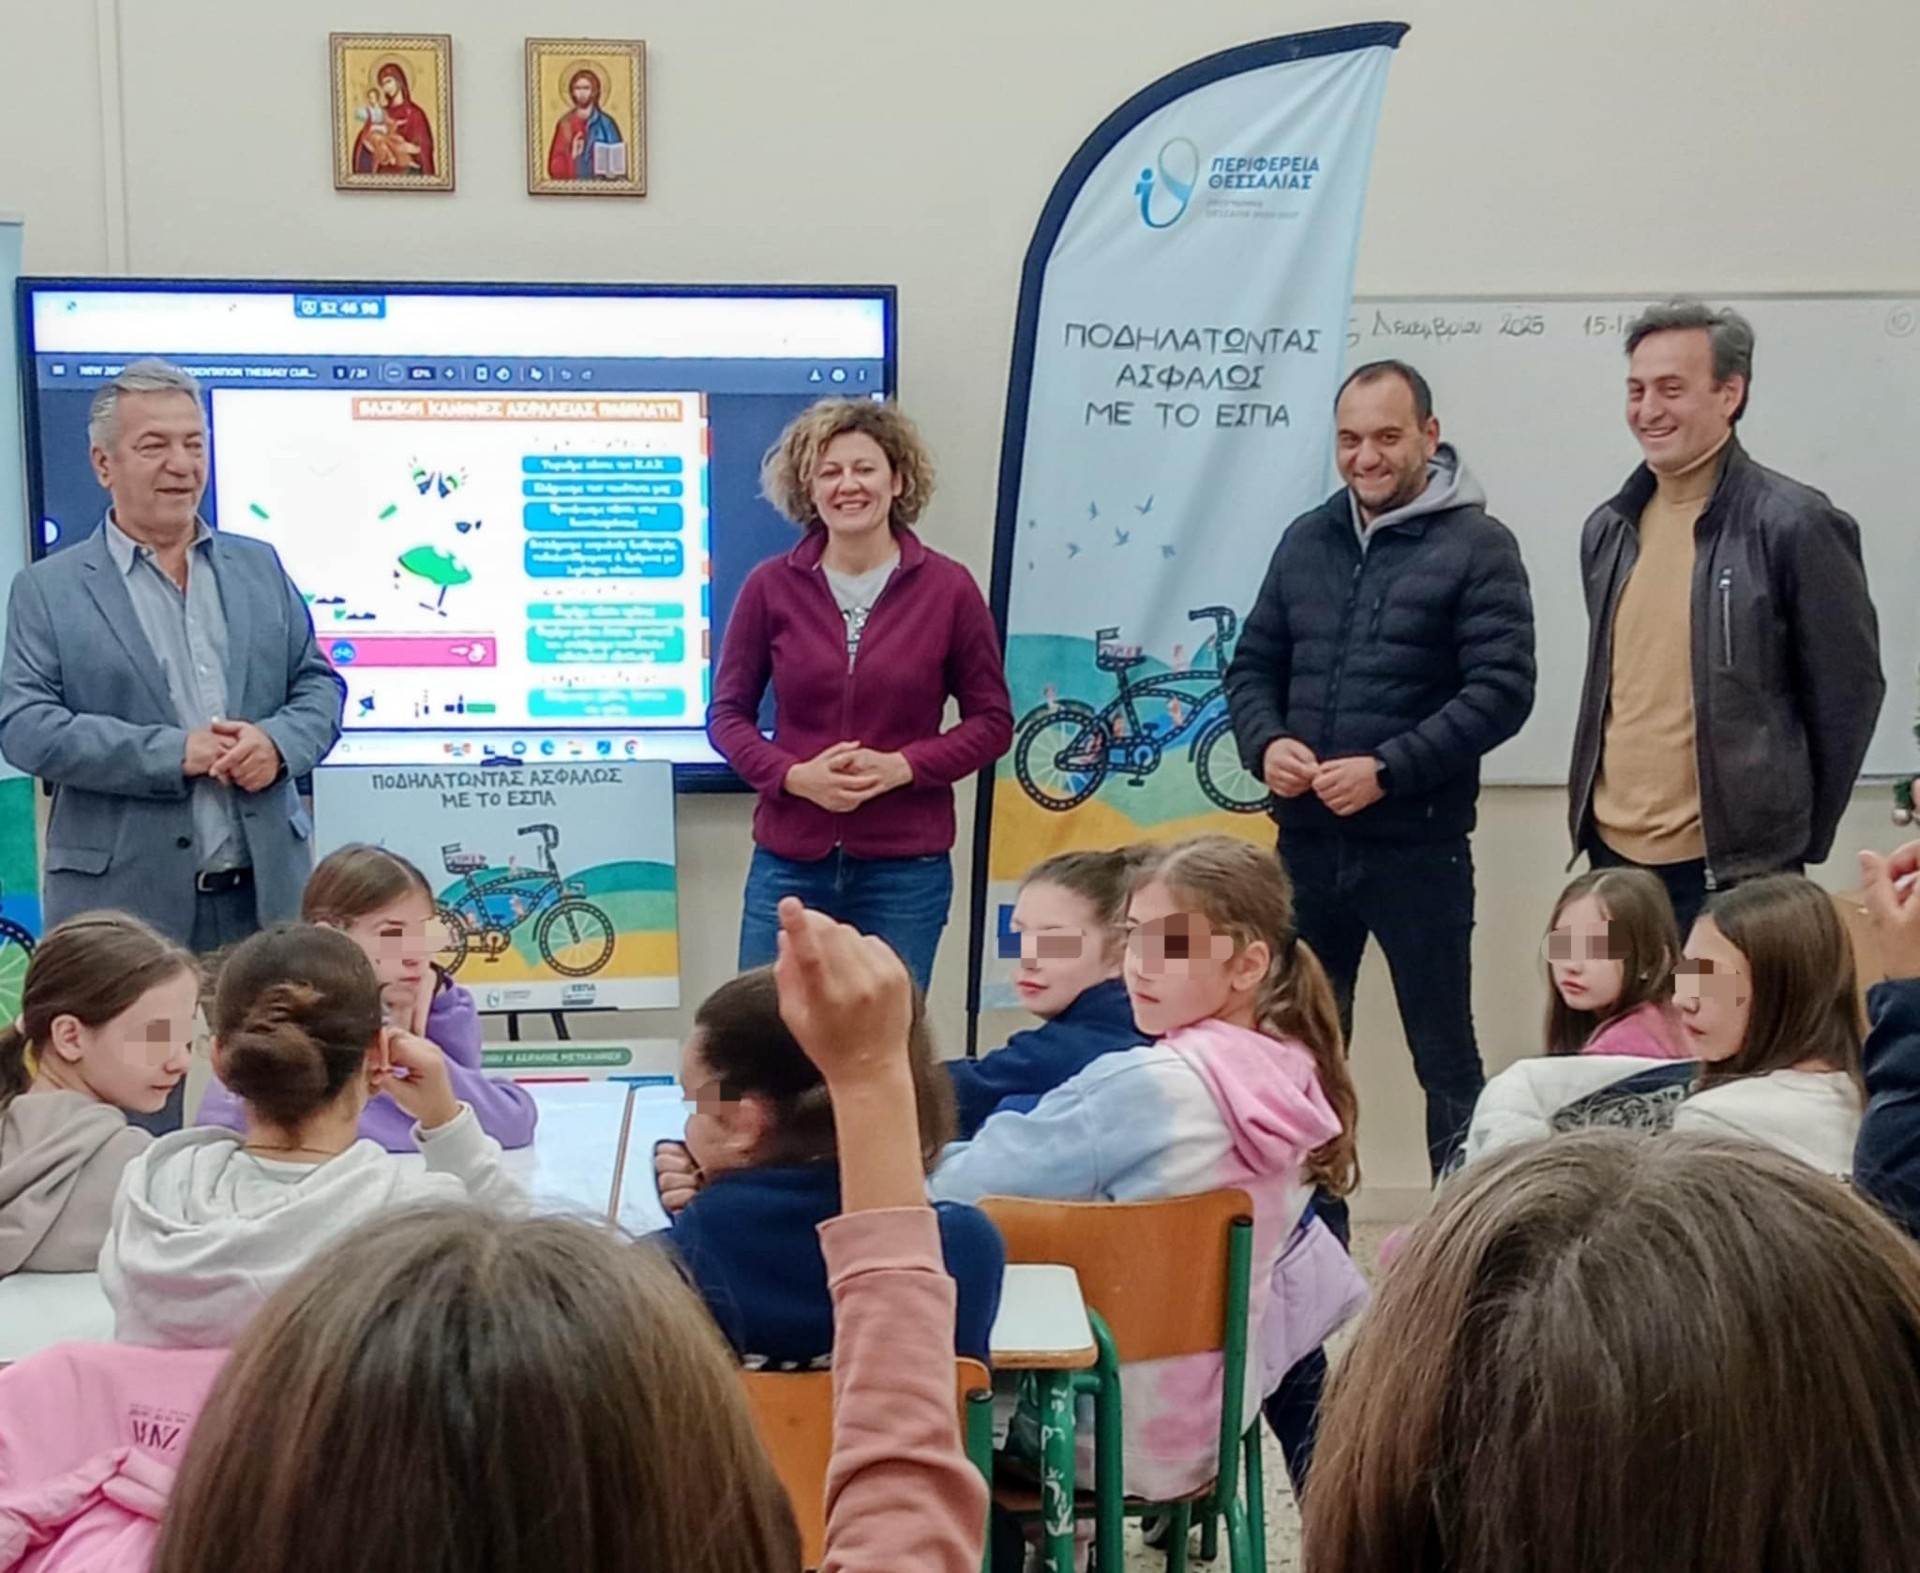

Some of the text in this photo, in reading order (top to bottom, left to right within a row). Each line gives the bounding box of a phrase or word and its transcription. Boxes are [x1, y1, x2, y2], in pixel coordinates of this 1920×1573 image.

[1210, 156, 1320, 172] ΠΕΡΙΦΕΡΕΙΑ
[1208, 174, 1312, 190] ΘΕΣΣΑΛΙΑΣ
[1499, 312, 1545, 337] 2025
[1064, 323, 1322, 354] ΠΟΔΗΛΑΤΩΝΤΑΣ
[1116, 363, 1265, 391] ΑΣΦΑΛΩΣ
[1085, 401, 1291, 429] ΜΕ ΤΟ ΕΣΠΑ
[372, 768, 623, 790] ΠΟΔΗΛΑΤΩΝΤΑΣ ΑΣΦΑΛΩΣ
[441, 791, 557, 809] ΜΕ ΤΟ ΕΣΠΑ
